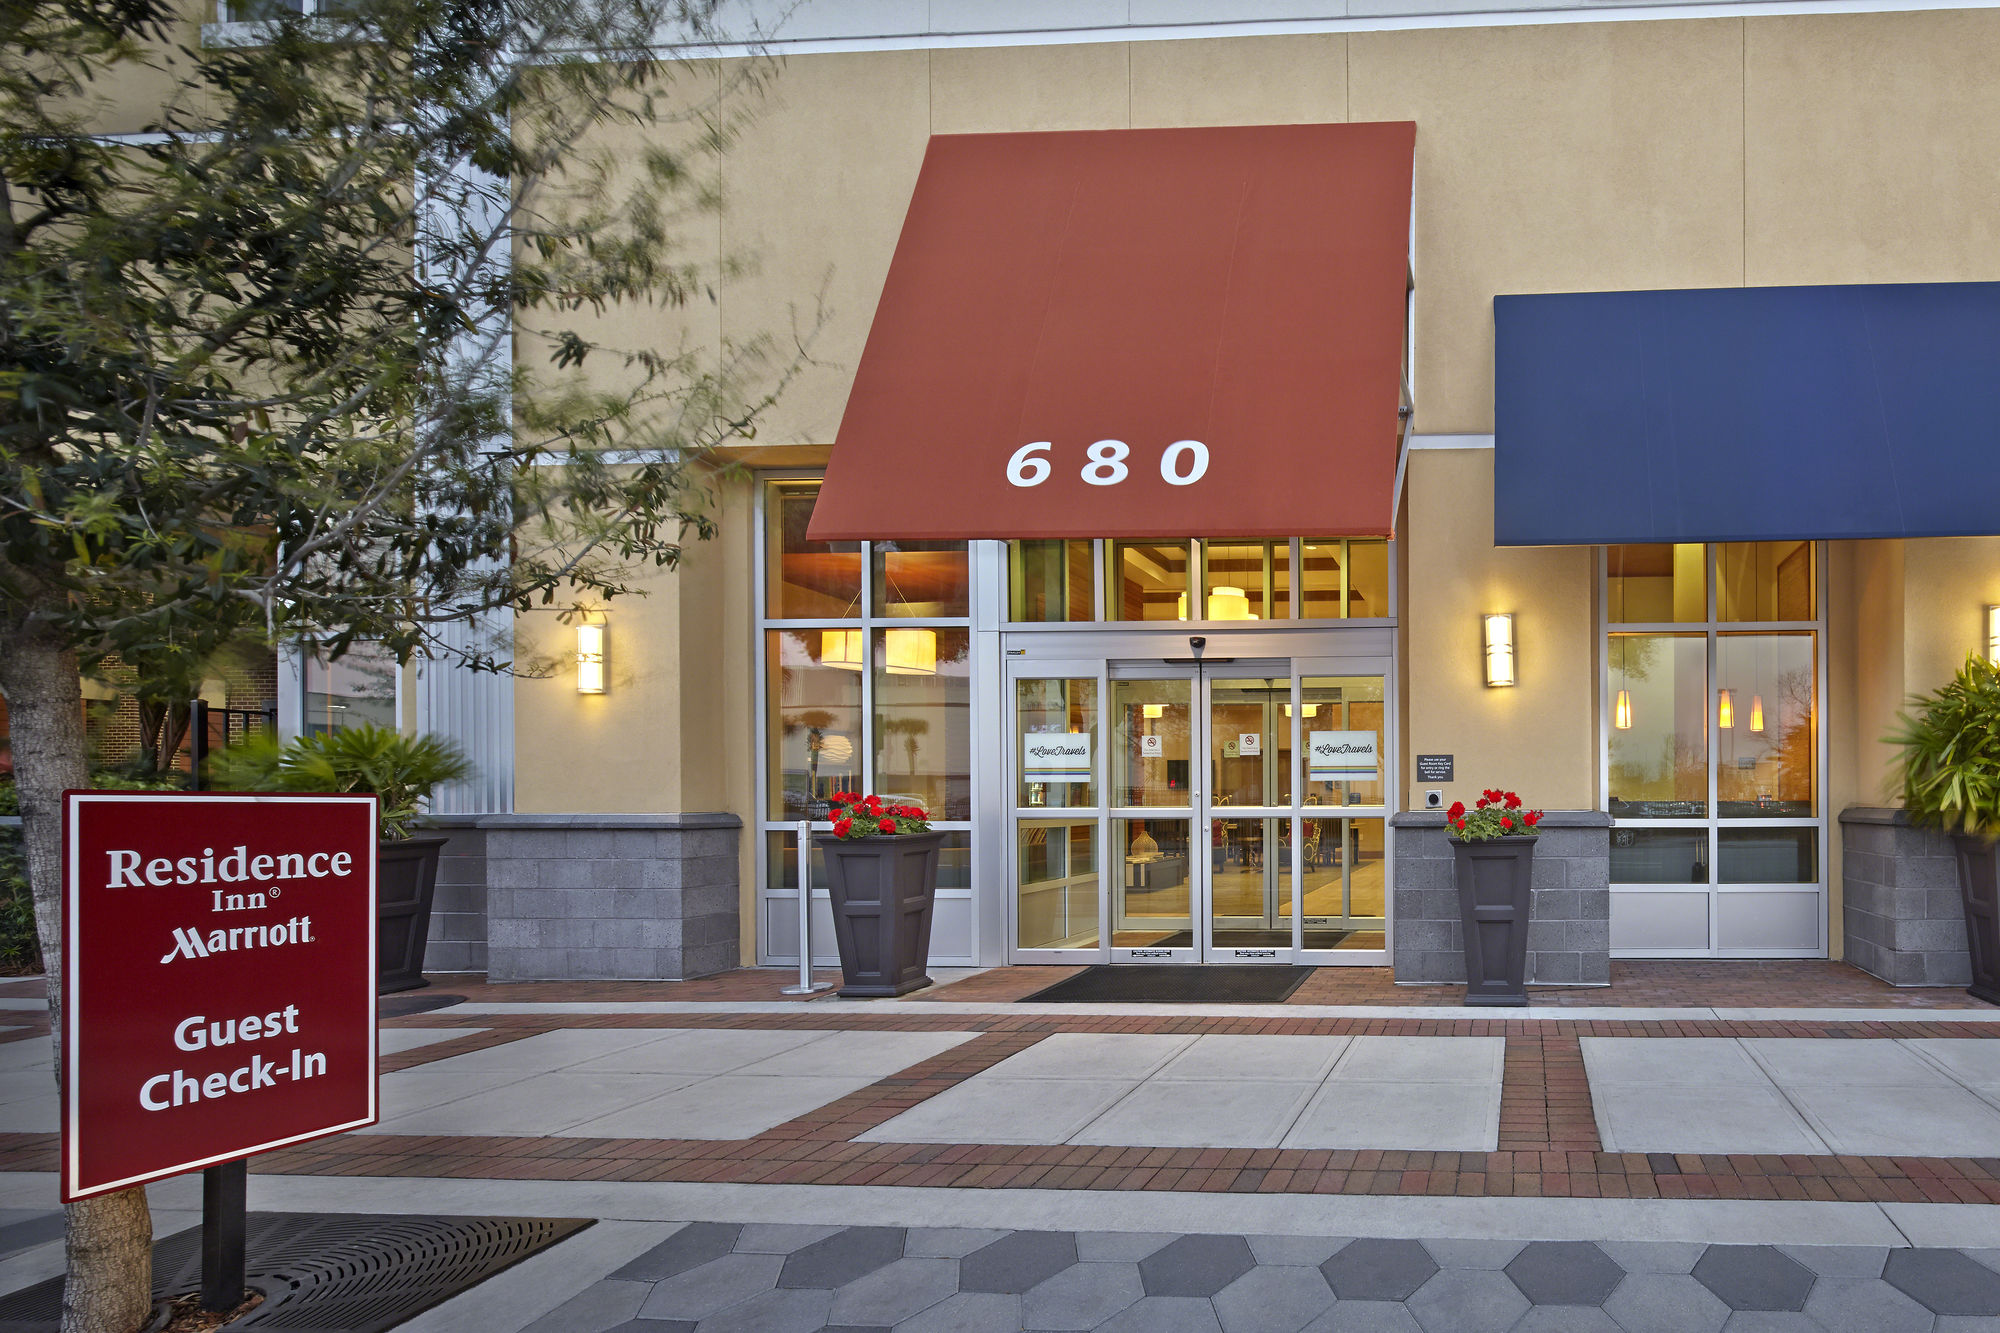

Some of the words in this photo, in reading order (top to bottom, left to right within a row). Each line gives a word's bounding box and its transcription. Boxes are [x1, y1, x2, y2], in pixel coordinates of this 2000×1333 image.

[1029, 745, 1087, 759] #LoveTravels
[1314, 743, 1373, 757] #LoveTravels
[106, 846, 351, 889] Residence
[173, 1003, 299, 1052] Guest
[139, 1048, 327, 1112] Check-In
